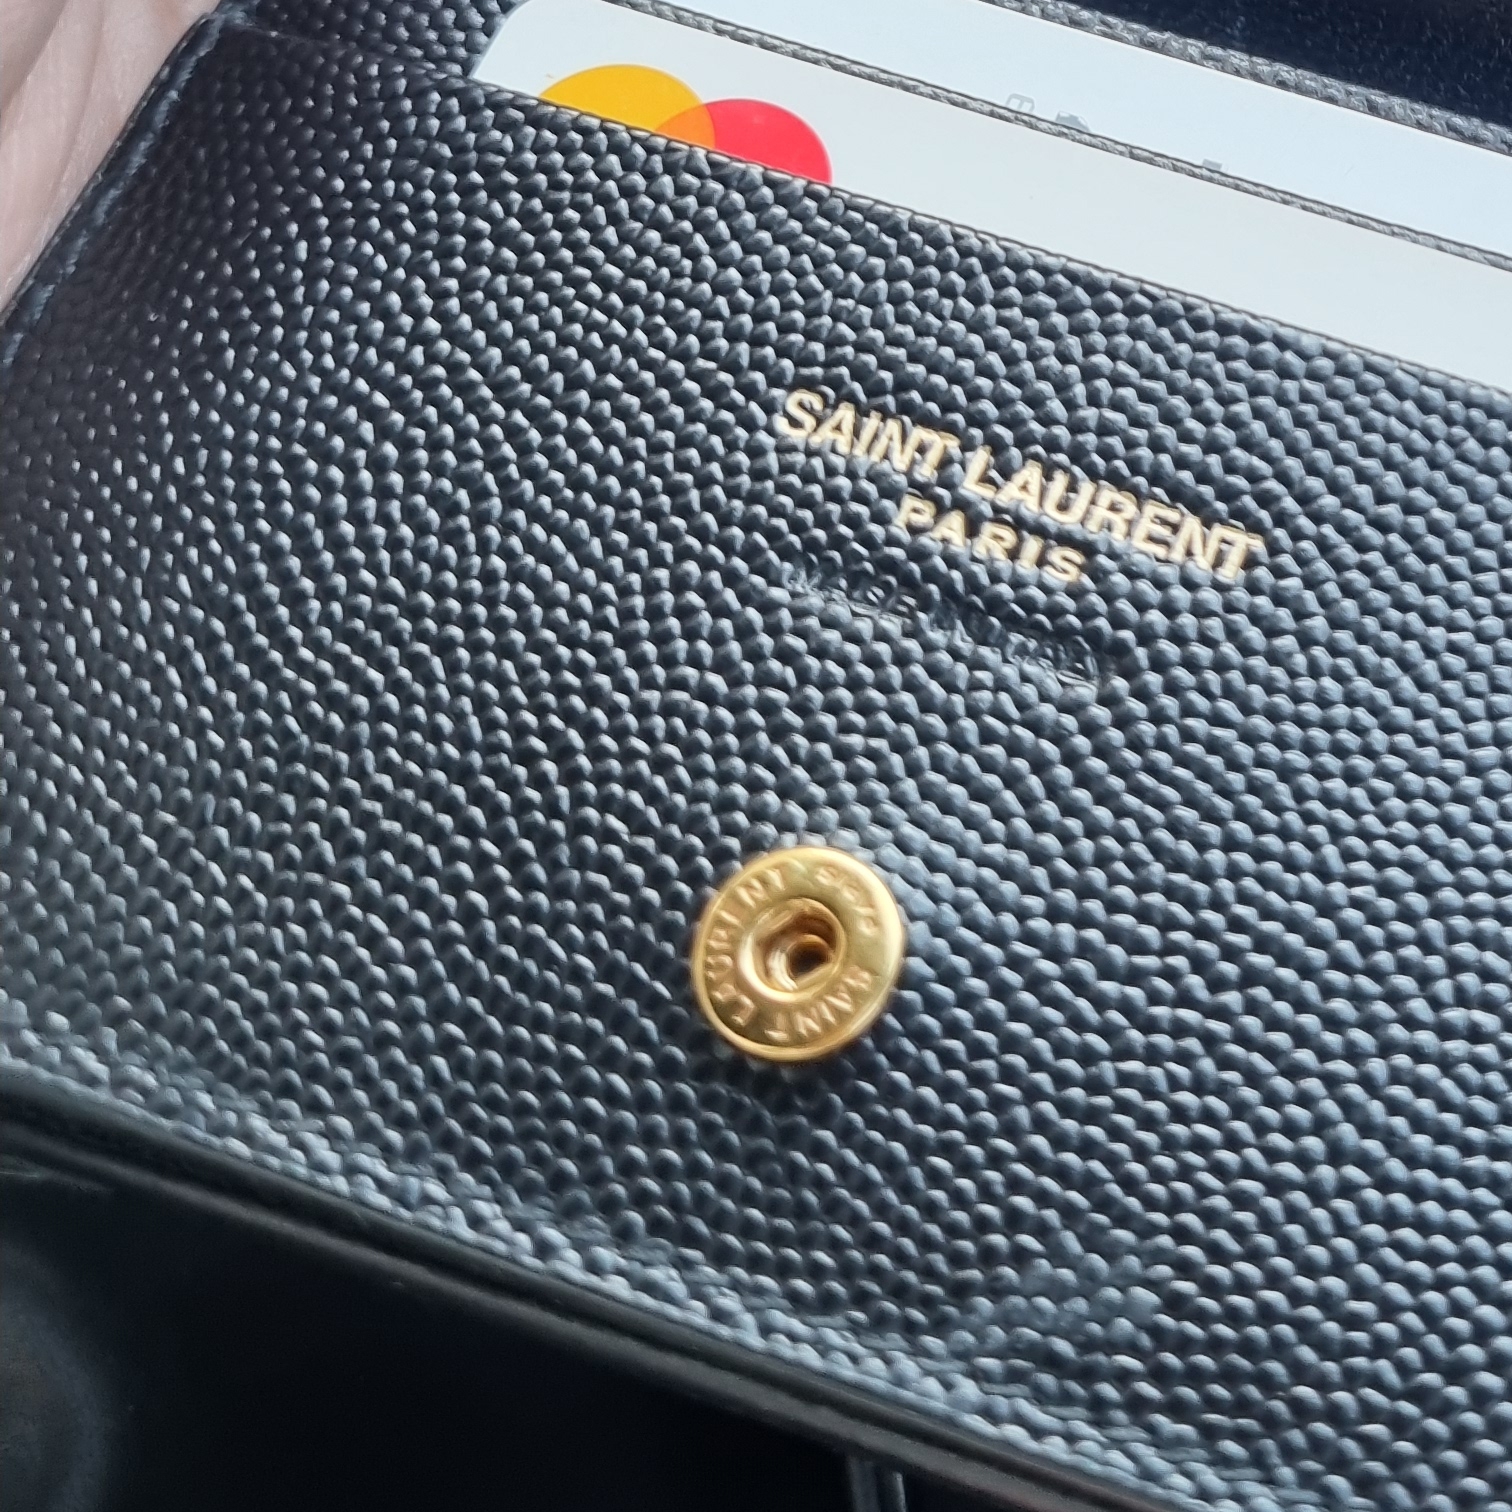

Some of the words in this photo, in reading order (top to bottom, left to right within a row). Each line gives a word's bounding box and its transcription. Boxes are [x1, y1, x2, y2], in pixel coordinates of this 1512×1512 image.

[775, 387, 960, 480] SAINT
[958, 445, 1266, 582] LAURENT
[893, 494, 1088, 583] PARIS
